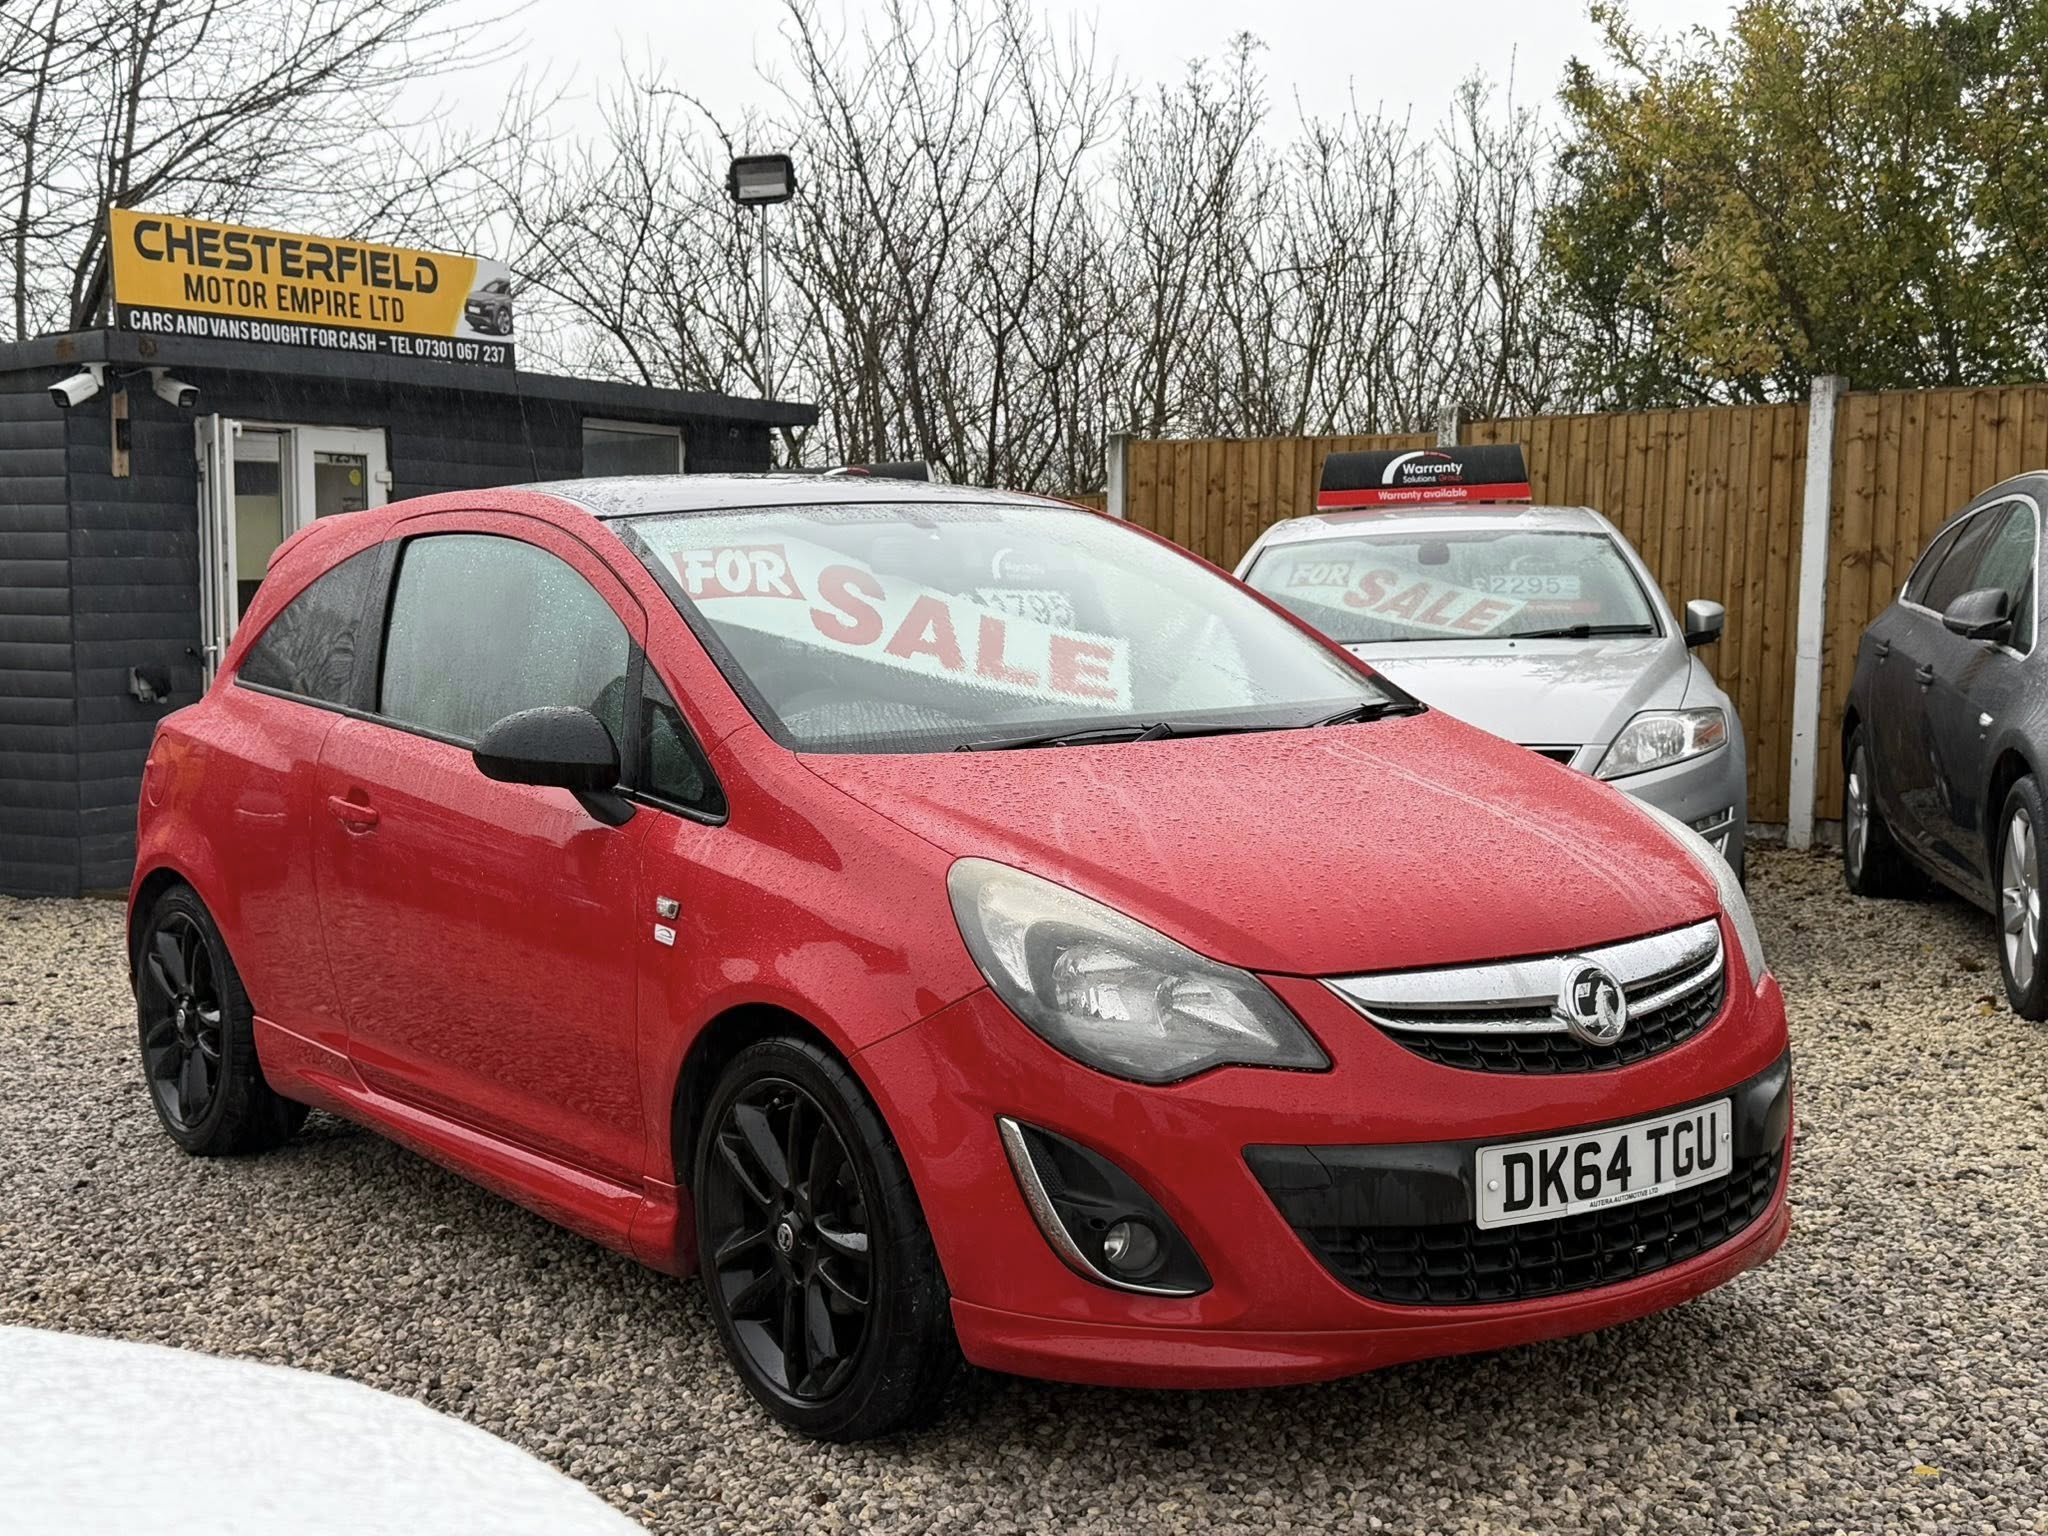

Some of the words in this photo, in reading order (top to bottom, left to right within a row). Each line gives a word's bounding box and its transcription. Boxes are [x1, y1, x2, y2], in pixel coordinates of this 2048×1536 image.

[133, 219, 439, 294] CHESTERFIELD
[184, 272, 268, 310] MOTOR
[276, 284, 362, 319] EMPIRE
[369, 294, 405, 323] LTD
[130, 310, 174, 333] CARS
[176, 314, 208, 335] AND
[208, 318, 249, 340] VANS
[250, 322, 309, 345] BOUGHT
[310, 328, 338, 349] FOR
[339, 330, 376, 351] CASH
[389, 336, 414, 355] TEL
[415, 338, 453, 358] 07301
[457, 343, 479, 360] 067
[483, 345, 505, 363] 237
[1378, 490, 1422, 501] Warranty
[1423, 488, 1467, 498] available
[1402, 462, 1463, 475] Warranty
[1403, 475, 1436, 483] Solutions
[1291, 562, 1348, 585] FOR
[1344, 569, 1513, 631] SALE
[683, 545, 792, 596] FOR
[809, 564, 1120, 703] SALE
[1502, 1135, 1632, 1213] DK64
[1646, 1112, 1717, 1184] TGU
[1613, 1189, 1648, 1203] AUTOMOTIVE
[1648, 1186, 1659, 1197] LTD
